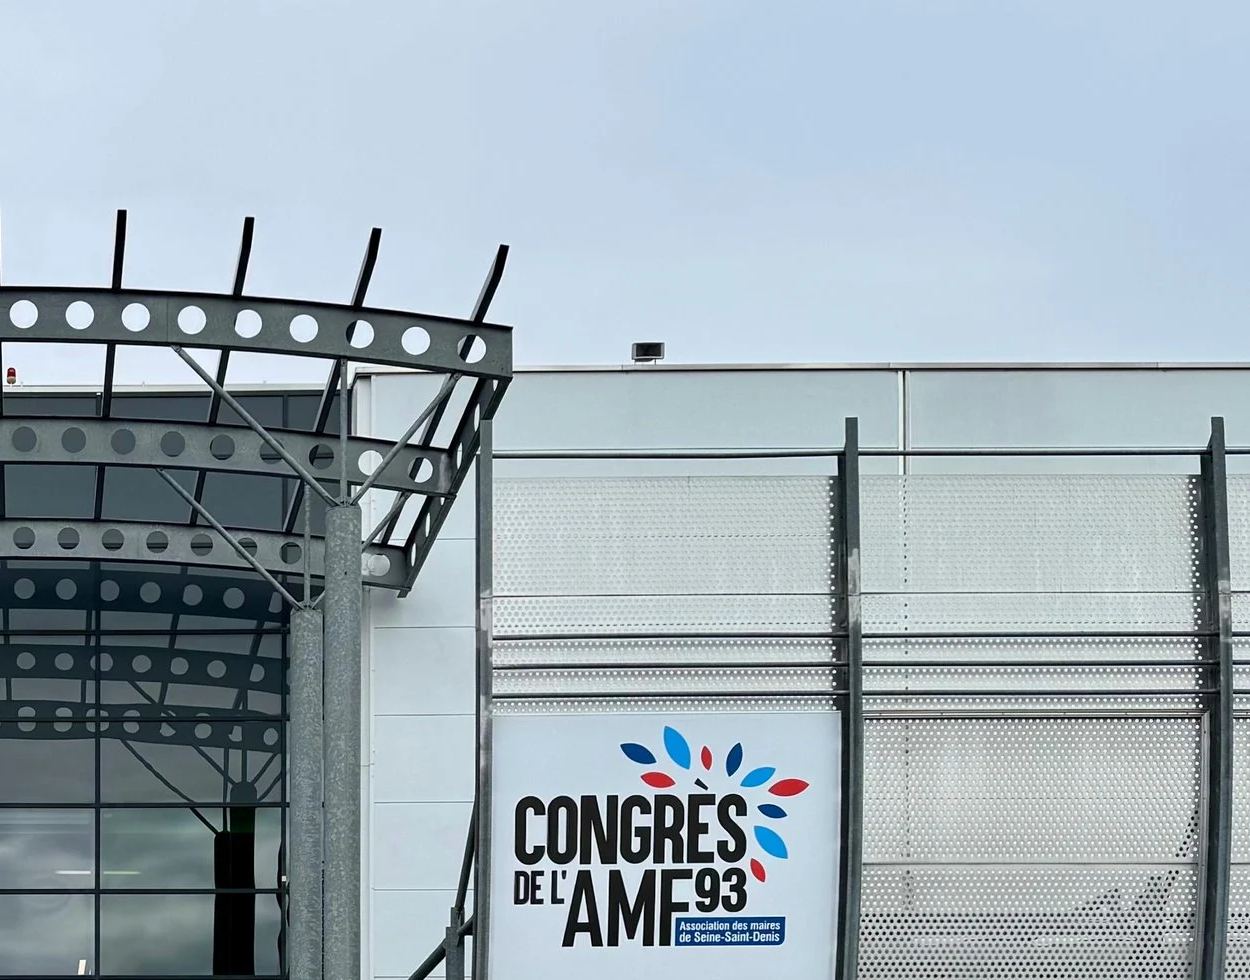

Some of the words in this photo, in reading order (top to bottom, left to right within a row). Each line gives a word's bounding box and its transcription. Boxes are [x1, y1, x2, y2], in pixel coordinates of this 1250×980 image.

[514, 778, 748, 865] CONGRÈS
[514, 870, 544, 905] DE
[679, 921, 730, 931] Association
[732, 921, 748, 931] des
[750, 921, 781, 931] maires
[679, 932, 691, 943] de
[694, 931, 780, 943] Seine-Saint-Denis
